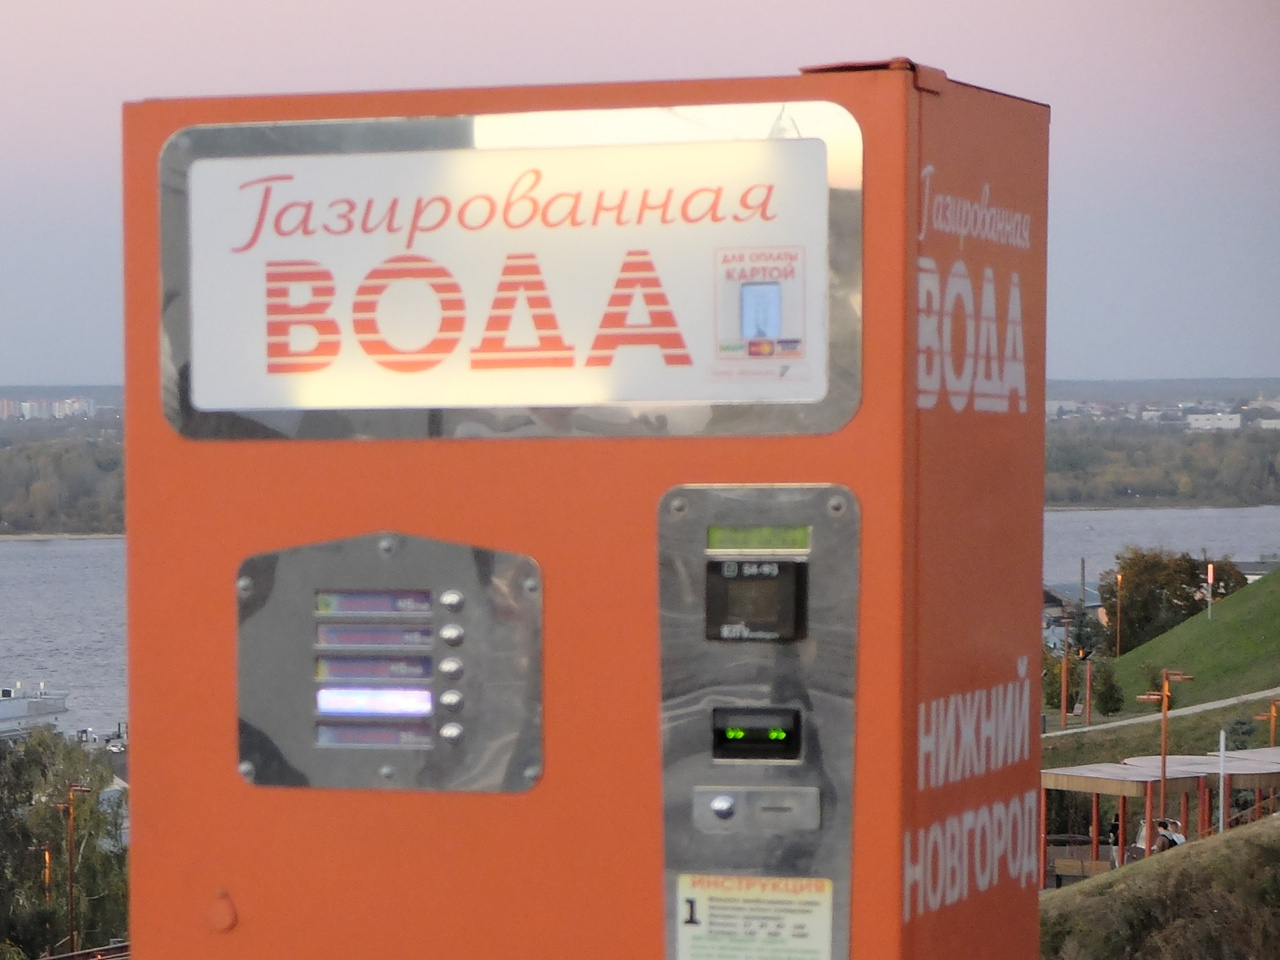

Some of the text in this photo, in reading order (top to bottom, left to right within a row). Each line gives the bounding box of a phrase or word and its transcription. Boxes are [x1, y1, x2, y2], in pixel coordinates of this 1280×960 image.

[230, 167, 778, 253] Газированная
[917, 164, 1031, 252] Газированная
[264, 249, 694, 374] ВОДА
[726, 262, 796, 281] КАРТОЙ
[916, 256, 1028, 414] ВОДА
[917, 655, 1031, 792] НИЖНИЙ
[691, 874, 826, 895] ИНСТРУКЦИЯ
[903, 789, 1039, 924] НОВГОРОД
[684, 898, 701, 925] 1
